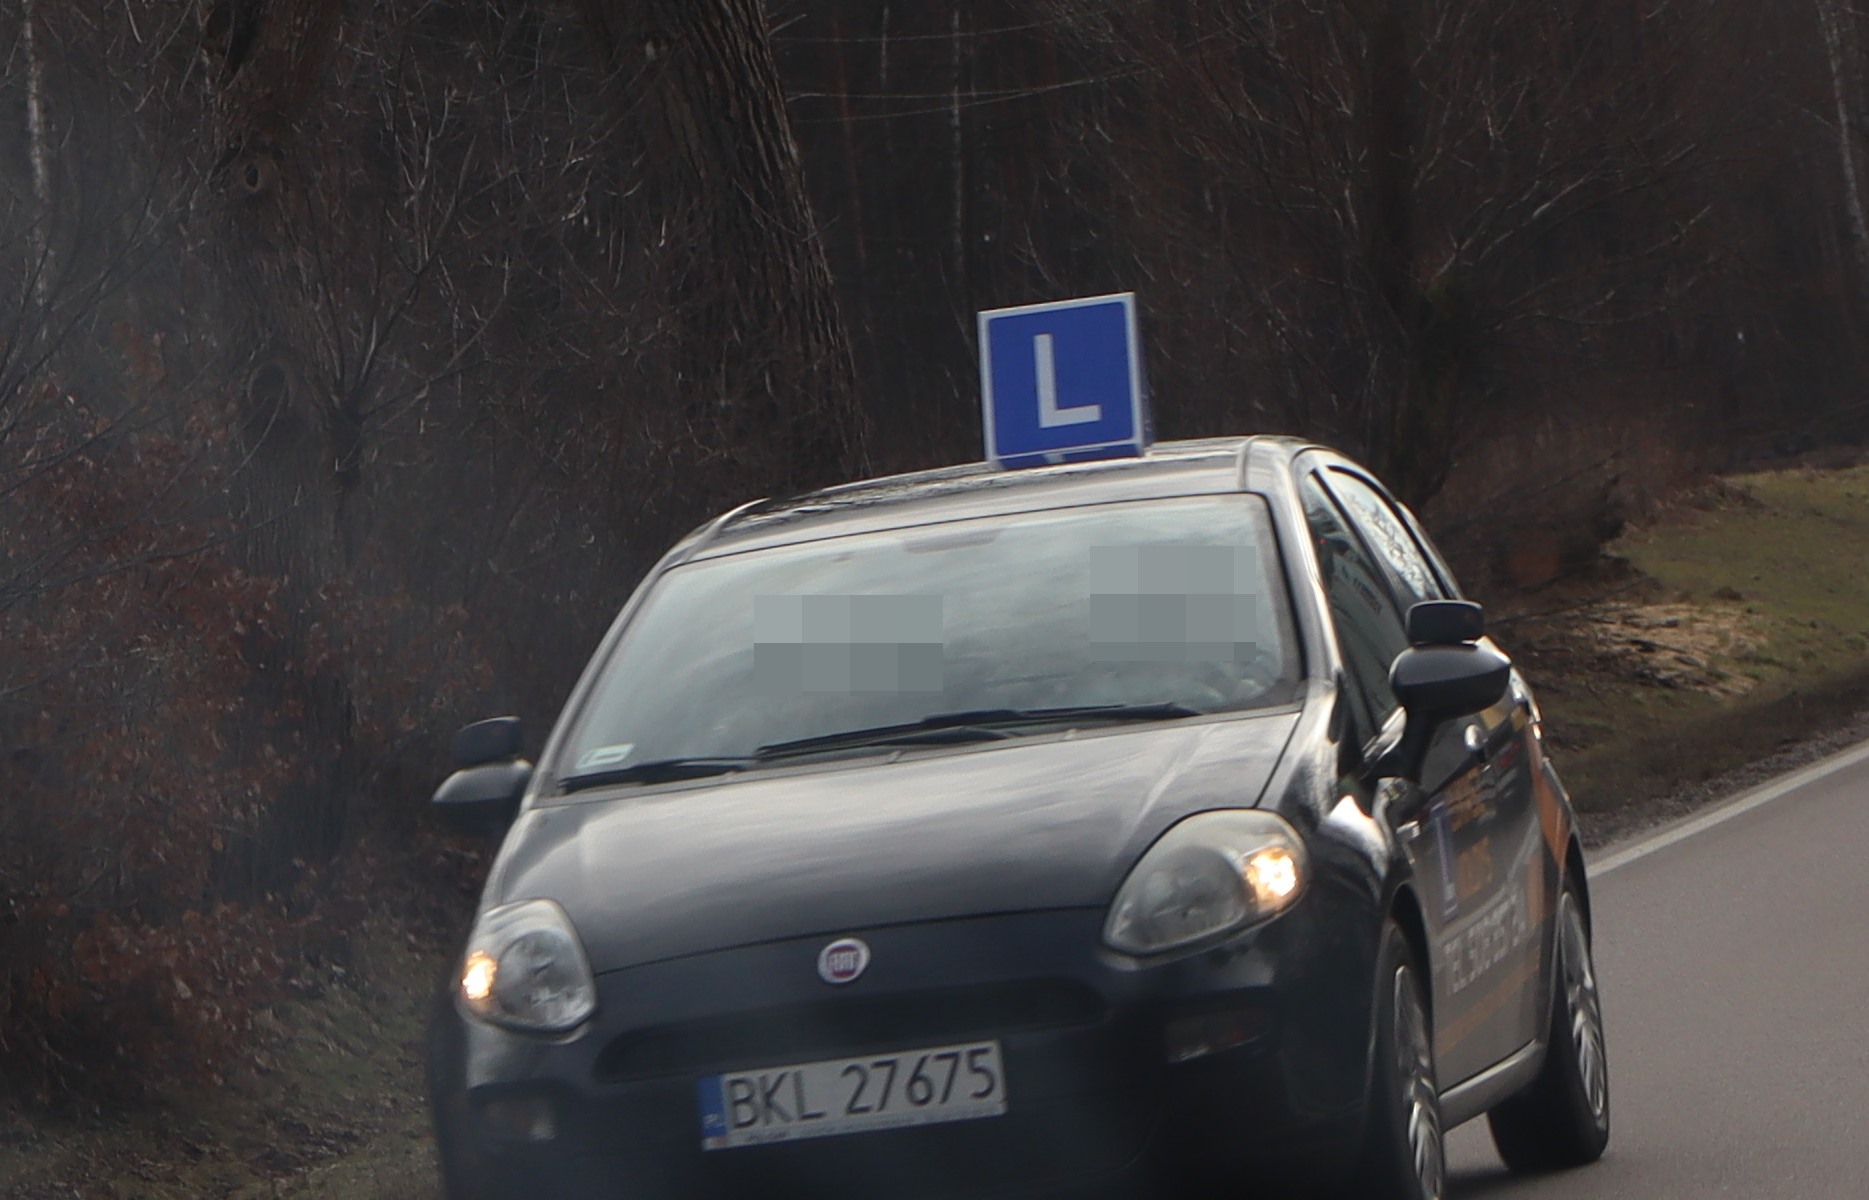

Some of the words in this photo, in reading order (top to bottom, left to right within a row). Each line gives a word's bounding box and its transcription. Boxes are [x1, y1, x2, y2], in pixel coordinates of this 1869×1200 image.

[1033, 333, 1102, 429] L
[725, 1070, 826, 1129] BKL
[841, 1047, 997, 1116] 27675
